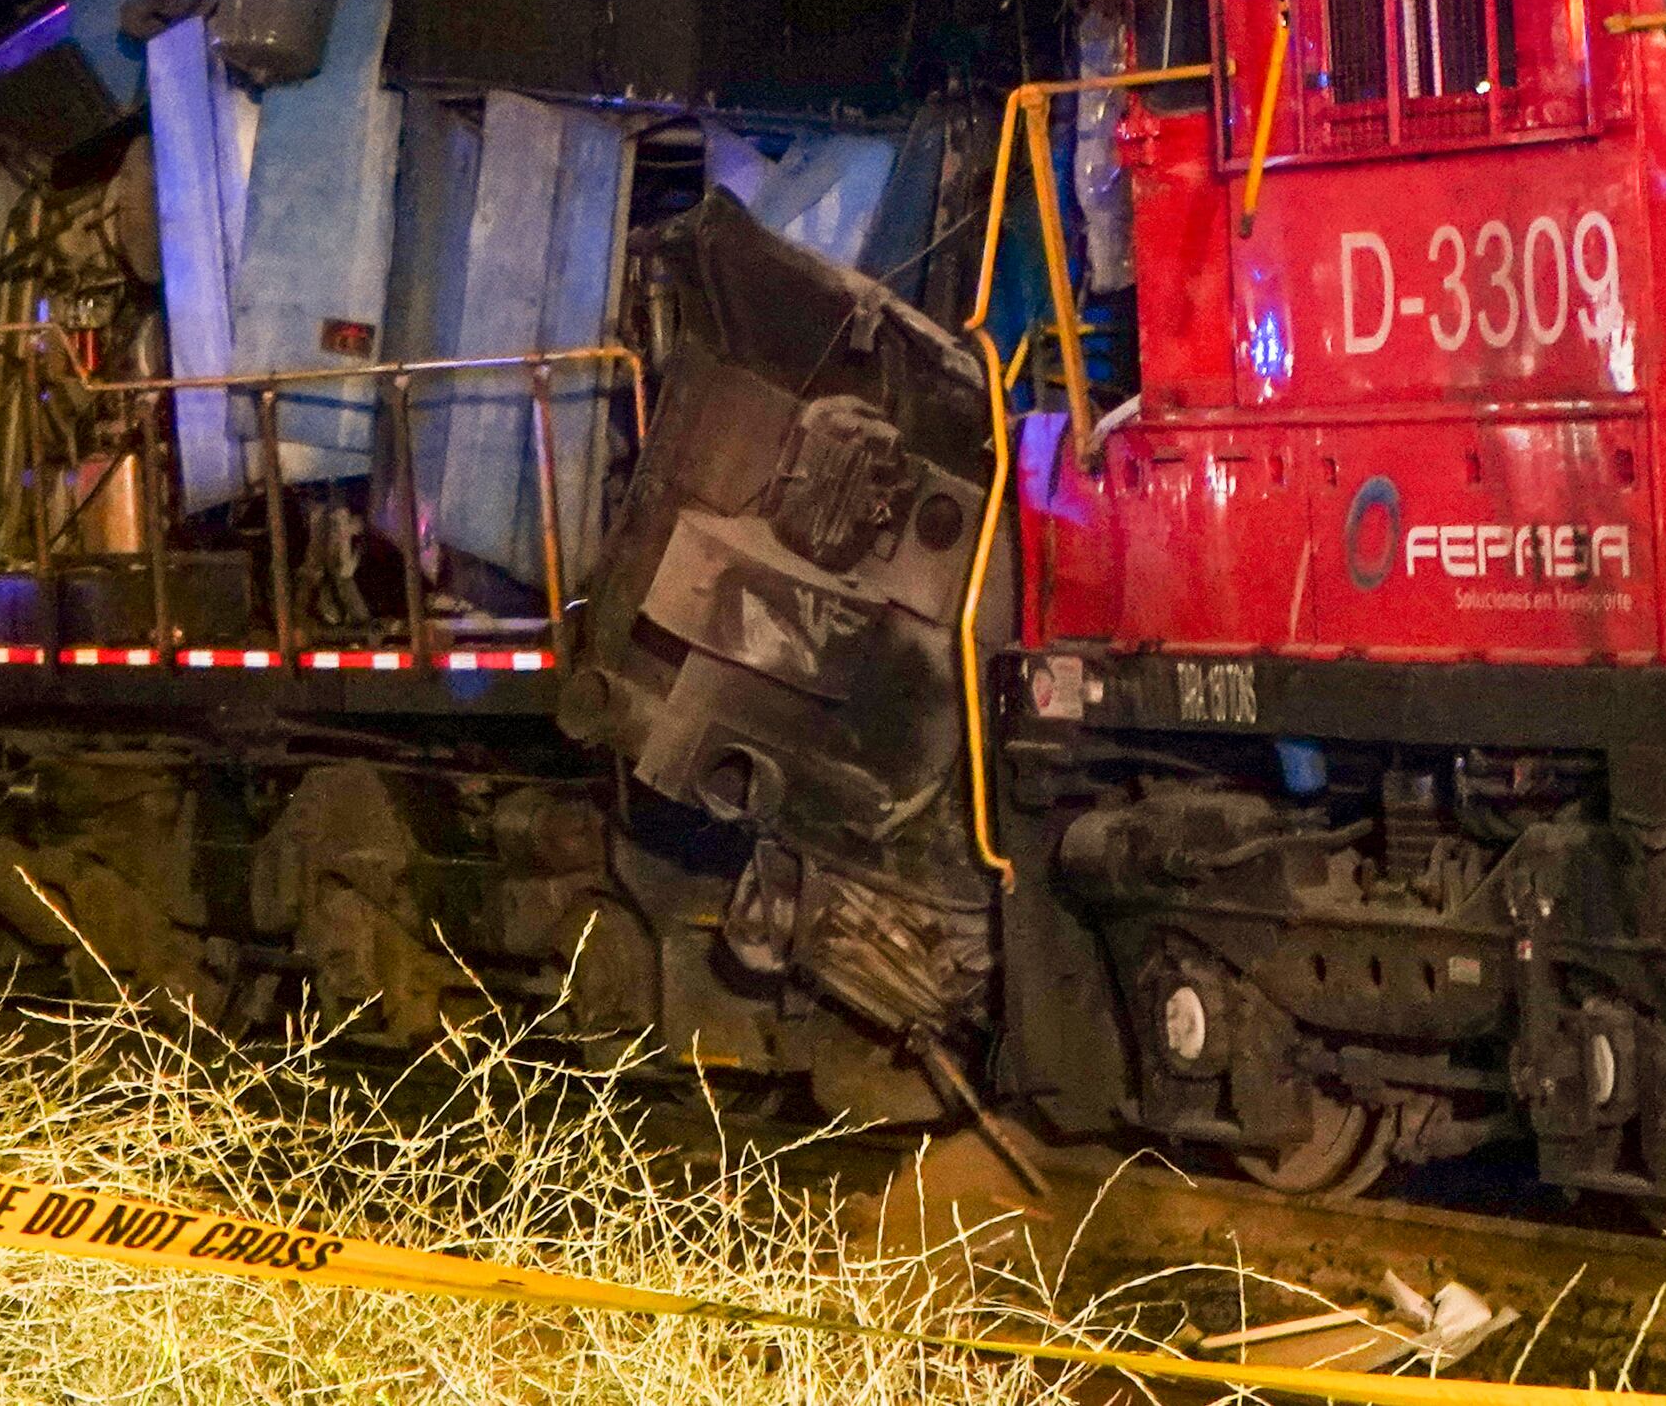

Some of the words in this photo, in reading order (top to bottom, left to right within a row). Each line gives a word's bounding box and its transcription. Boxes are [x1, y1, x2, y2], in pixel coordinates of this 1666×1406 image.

[1340, 210, 1622, 355] D-3309
[1406, 525, 1631, 578] FEPASA
[21, 1191, 98, 1240] DO
[88, 1203, 201, 1253] NOT
[189, 1222, 344, 1273] CROSS
